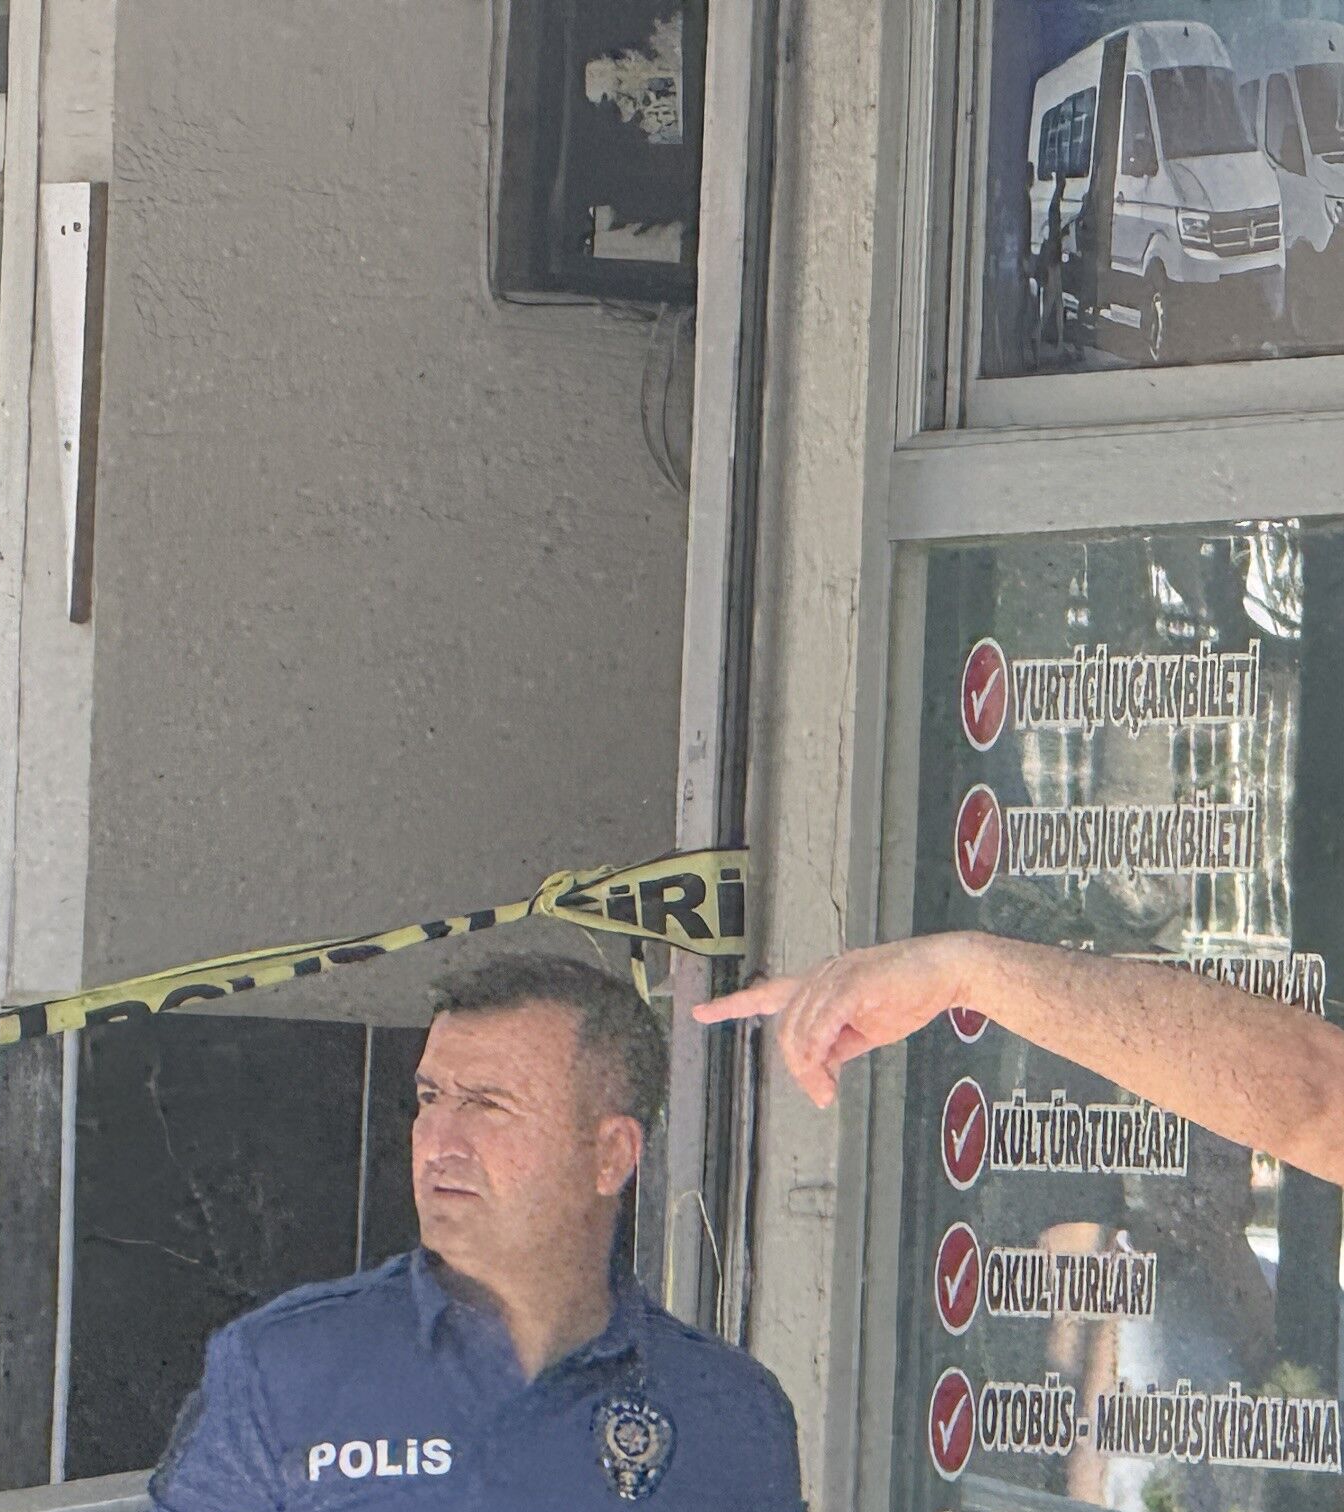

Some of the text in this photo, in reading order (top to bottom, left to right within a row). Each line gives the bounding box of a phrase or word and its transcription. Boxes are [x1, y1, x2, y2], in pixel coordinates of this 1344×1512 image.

[1109, 652, 1182, 739] UÇAK
[1105, 803, 1178, 884] UÇAK
[990, 1088, 1189, 1177] KÜLTÜR TURLARI
[985, 1246, 1157, 1320] OKUL TURLARI
[979, 1372, 1076, 1456] OTOBÜS
[1207, 1381, 1343, 1474] KİRALAMA
